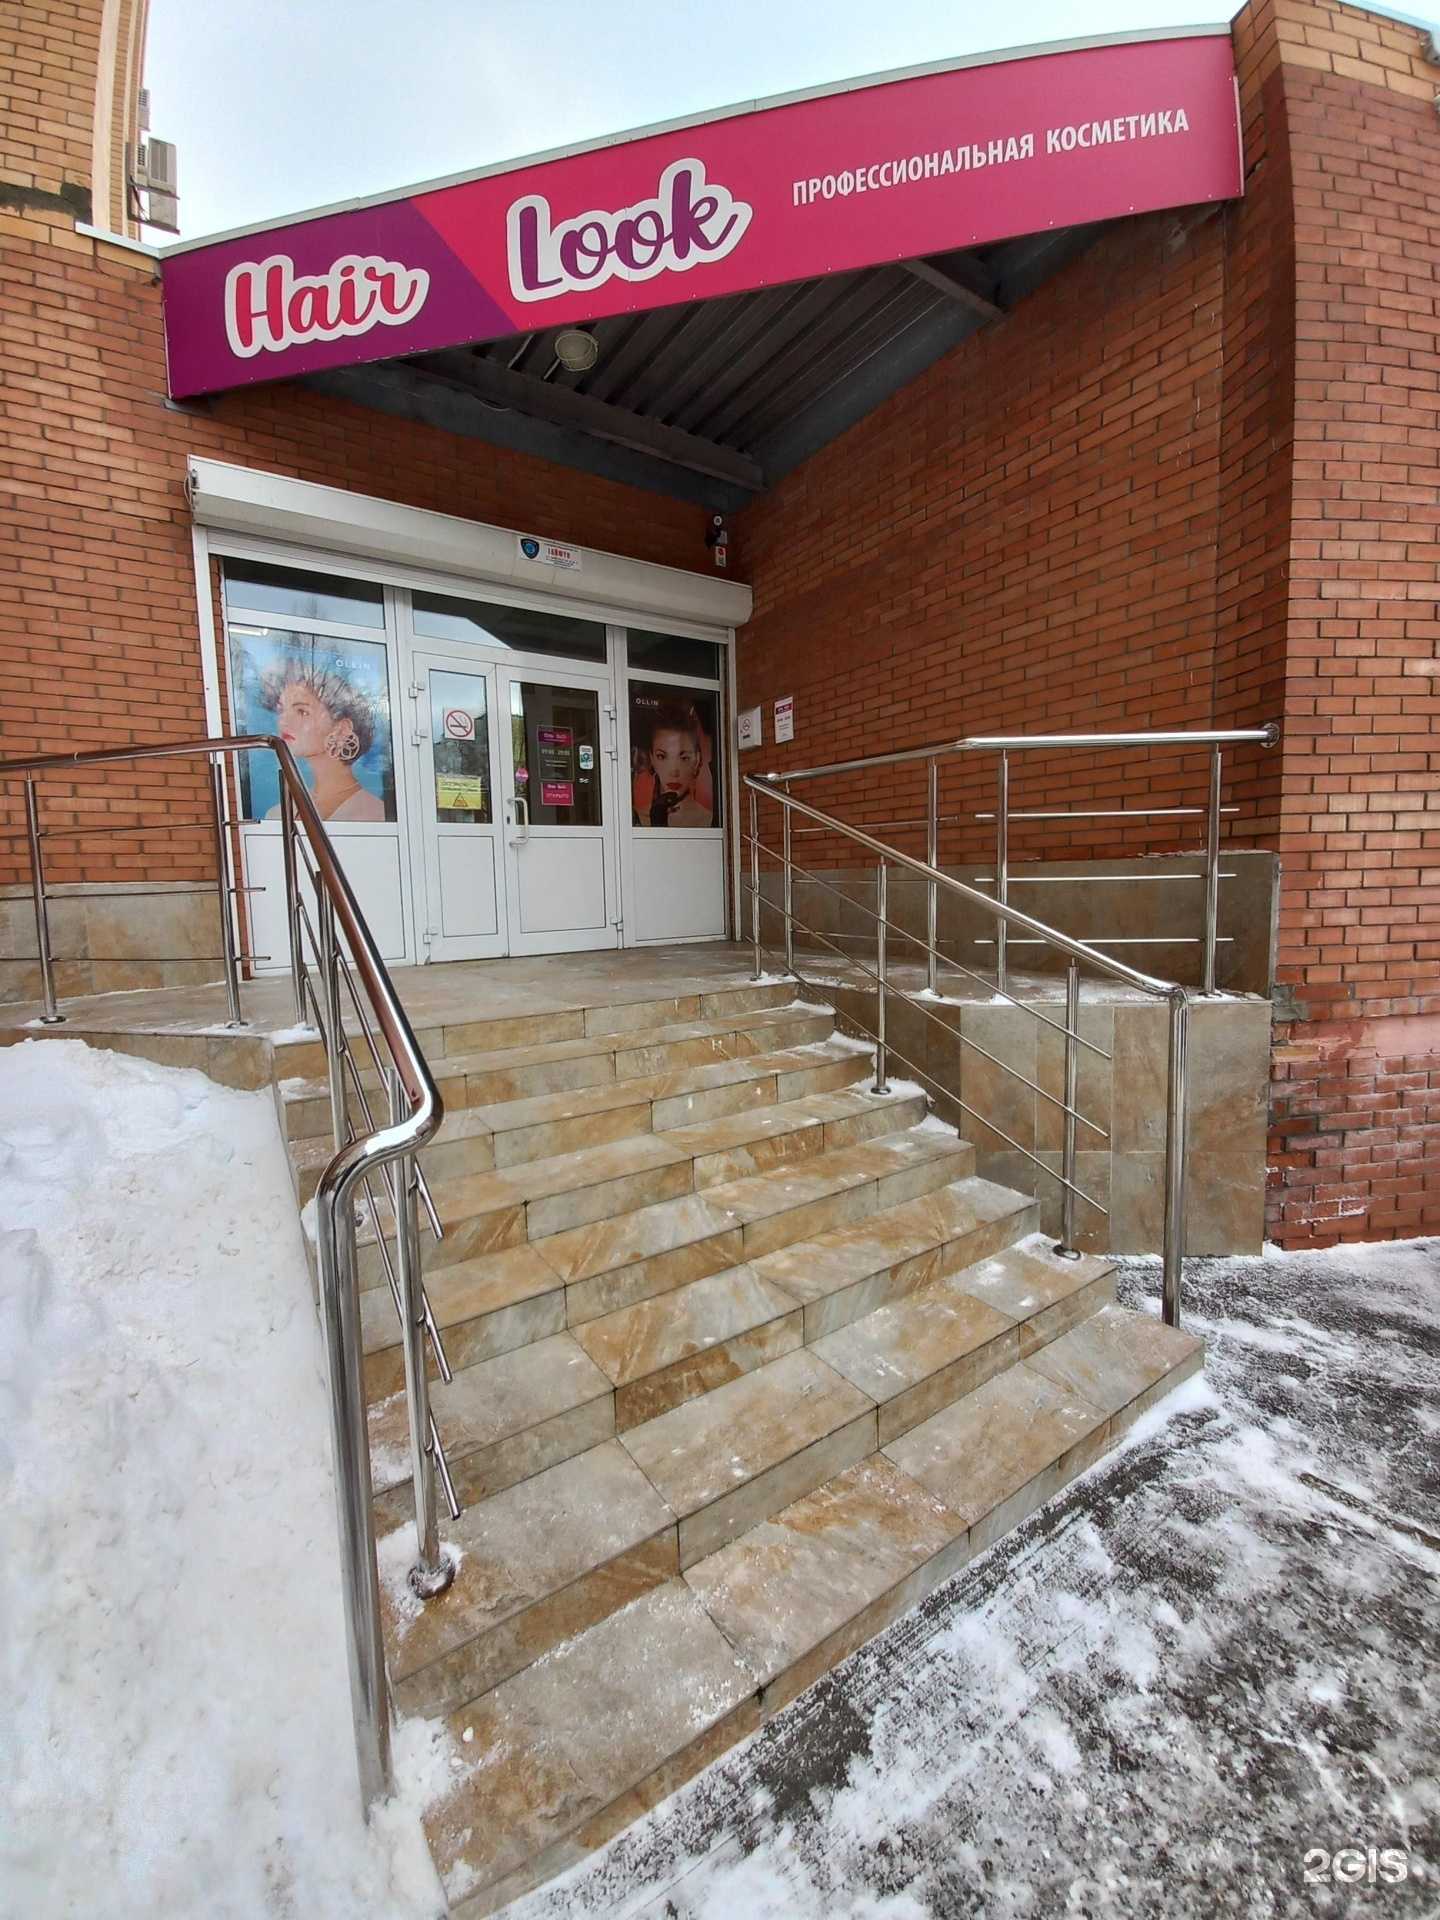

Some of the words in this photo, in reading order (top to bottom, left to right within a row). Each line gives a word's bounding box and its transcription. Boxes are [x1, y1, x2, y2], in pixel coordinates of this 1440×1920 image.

[792, 132, 1035, 206] ПРОФЕССИОНАЛЬНАЯ
[1046, 107, 1190, 154] КОСМЕТИКА
[225, 254, 430, 358] Hair
[507, 158, 752, 302] Look
